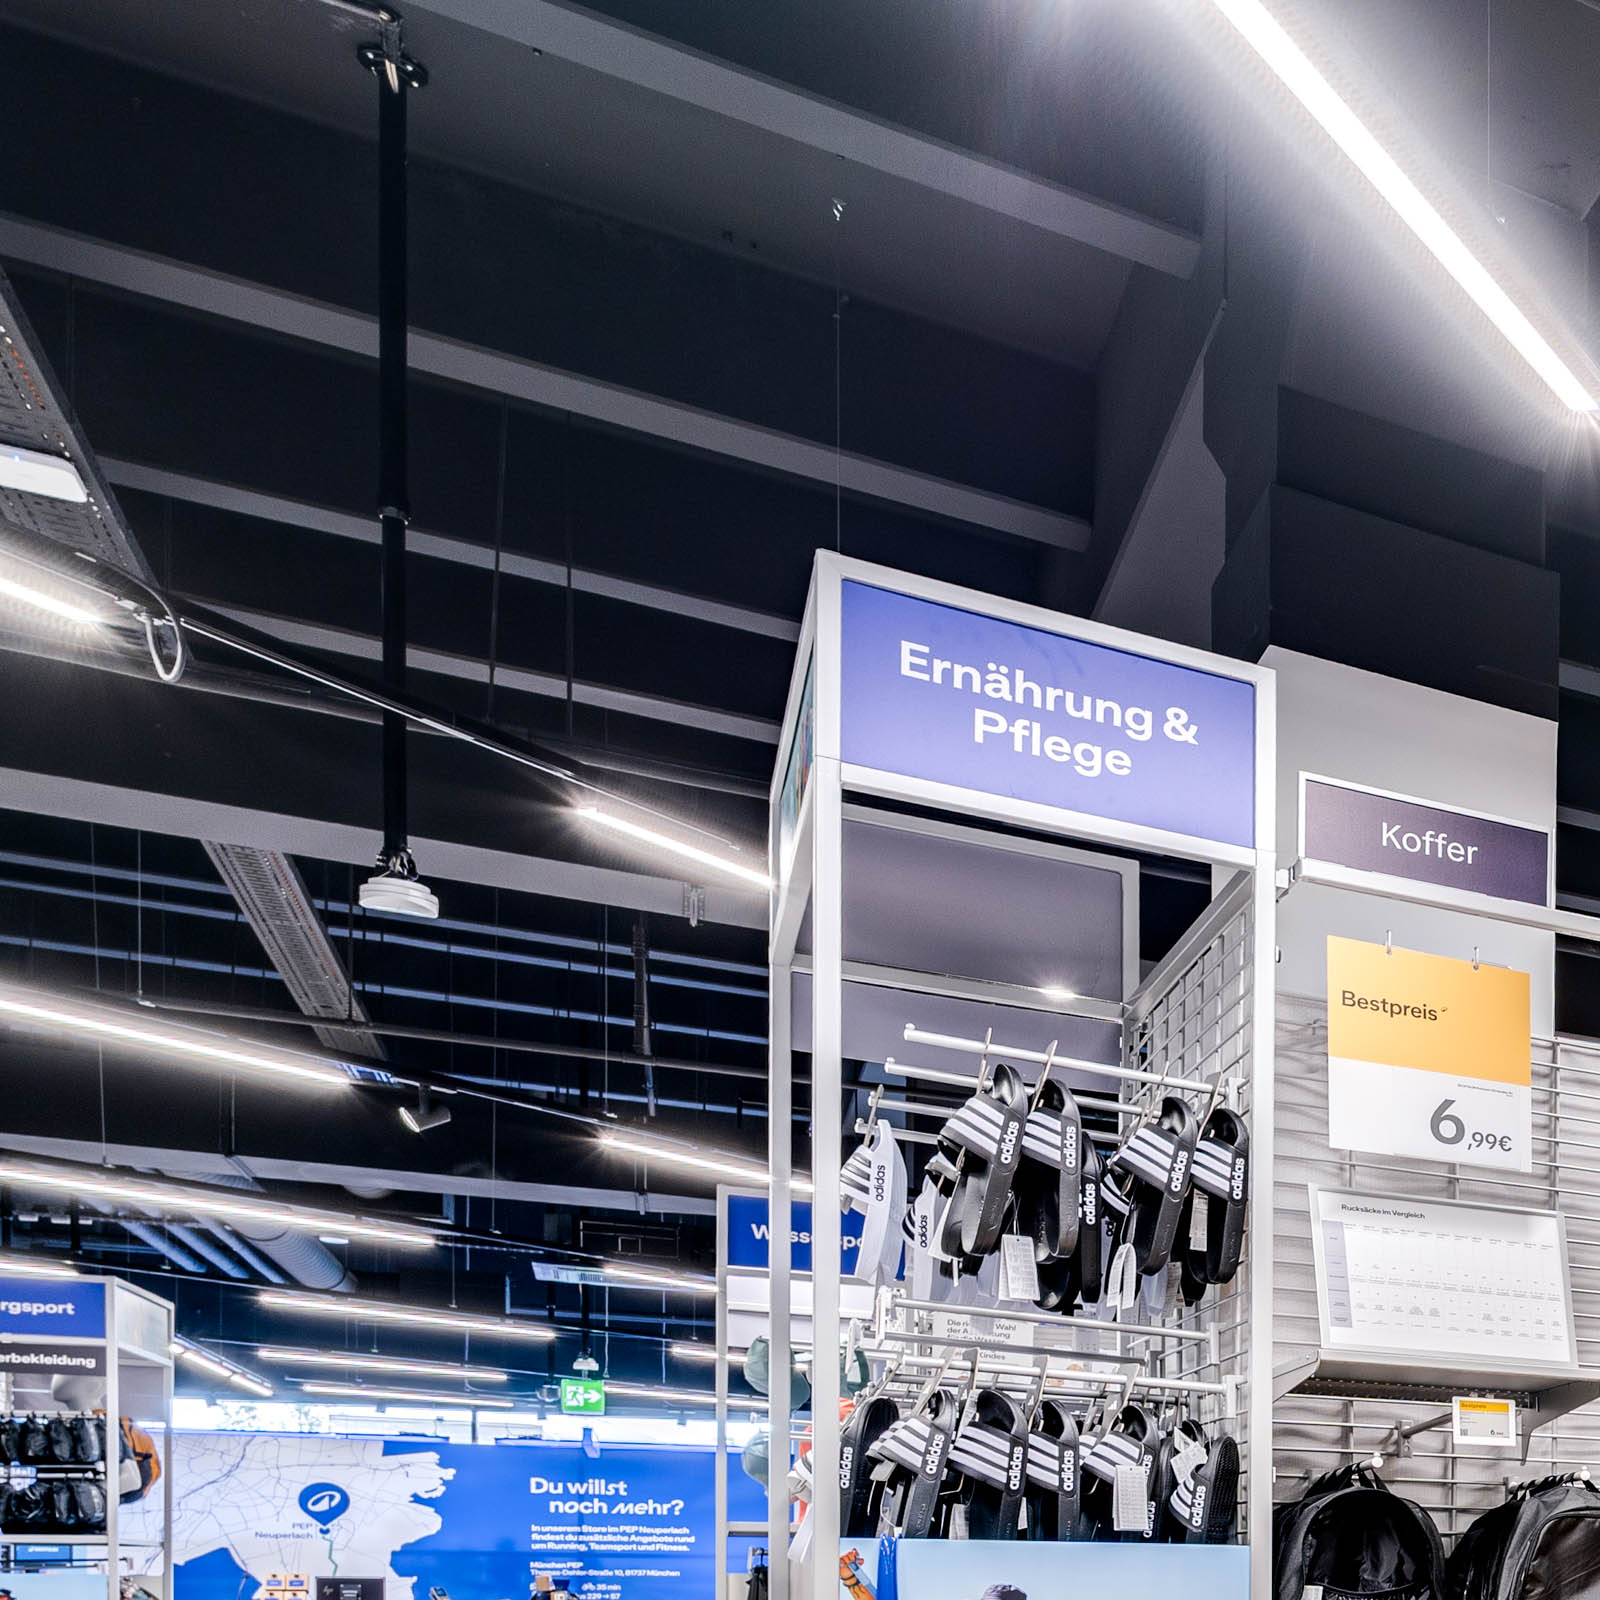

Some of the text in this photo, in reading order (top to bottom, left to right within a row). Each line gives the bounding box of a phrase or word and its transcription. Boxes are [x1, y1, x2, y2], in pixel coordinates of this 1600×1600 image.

[899, 640, 1199, 746] Ernährung &
[972, 707, 1133, 778] Pflege
[1381, 821, 1479, 865] Koffer
[1341, 990, 1439, 1021] Bestpreis
[1000, 1120, 1020, 1165] adidas
[1065, 1125, 1077, 1168] adidas
[875, 1164, 886, 1202] adidas
[1170, 1150, 1189, 1192] adidas
[1232, 1157, 1245, 1200] adidas
[1083, 1182, 1096, 1225] adidas
[920, 1214, 928, 1248] adidas
[840, 1446, 853, 1489] adidas
[925, 1433, 945, 1476] adidas
[1008, 1445, 1024, 1491] adidas
[1062, 1449, 1075, 1492] adidas
[530, 1477, 628, 1496] Du willst
[550, 1498, 685, 1516] noch mehr?
[1191, 1485, 1207, 1527] adidas
[638, 1543, 655, 1551] und
[675, 1535, 695, 1543] rund
